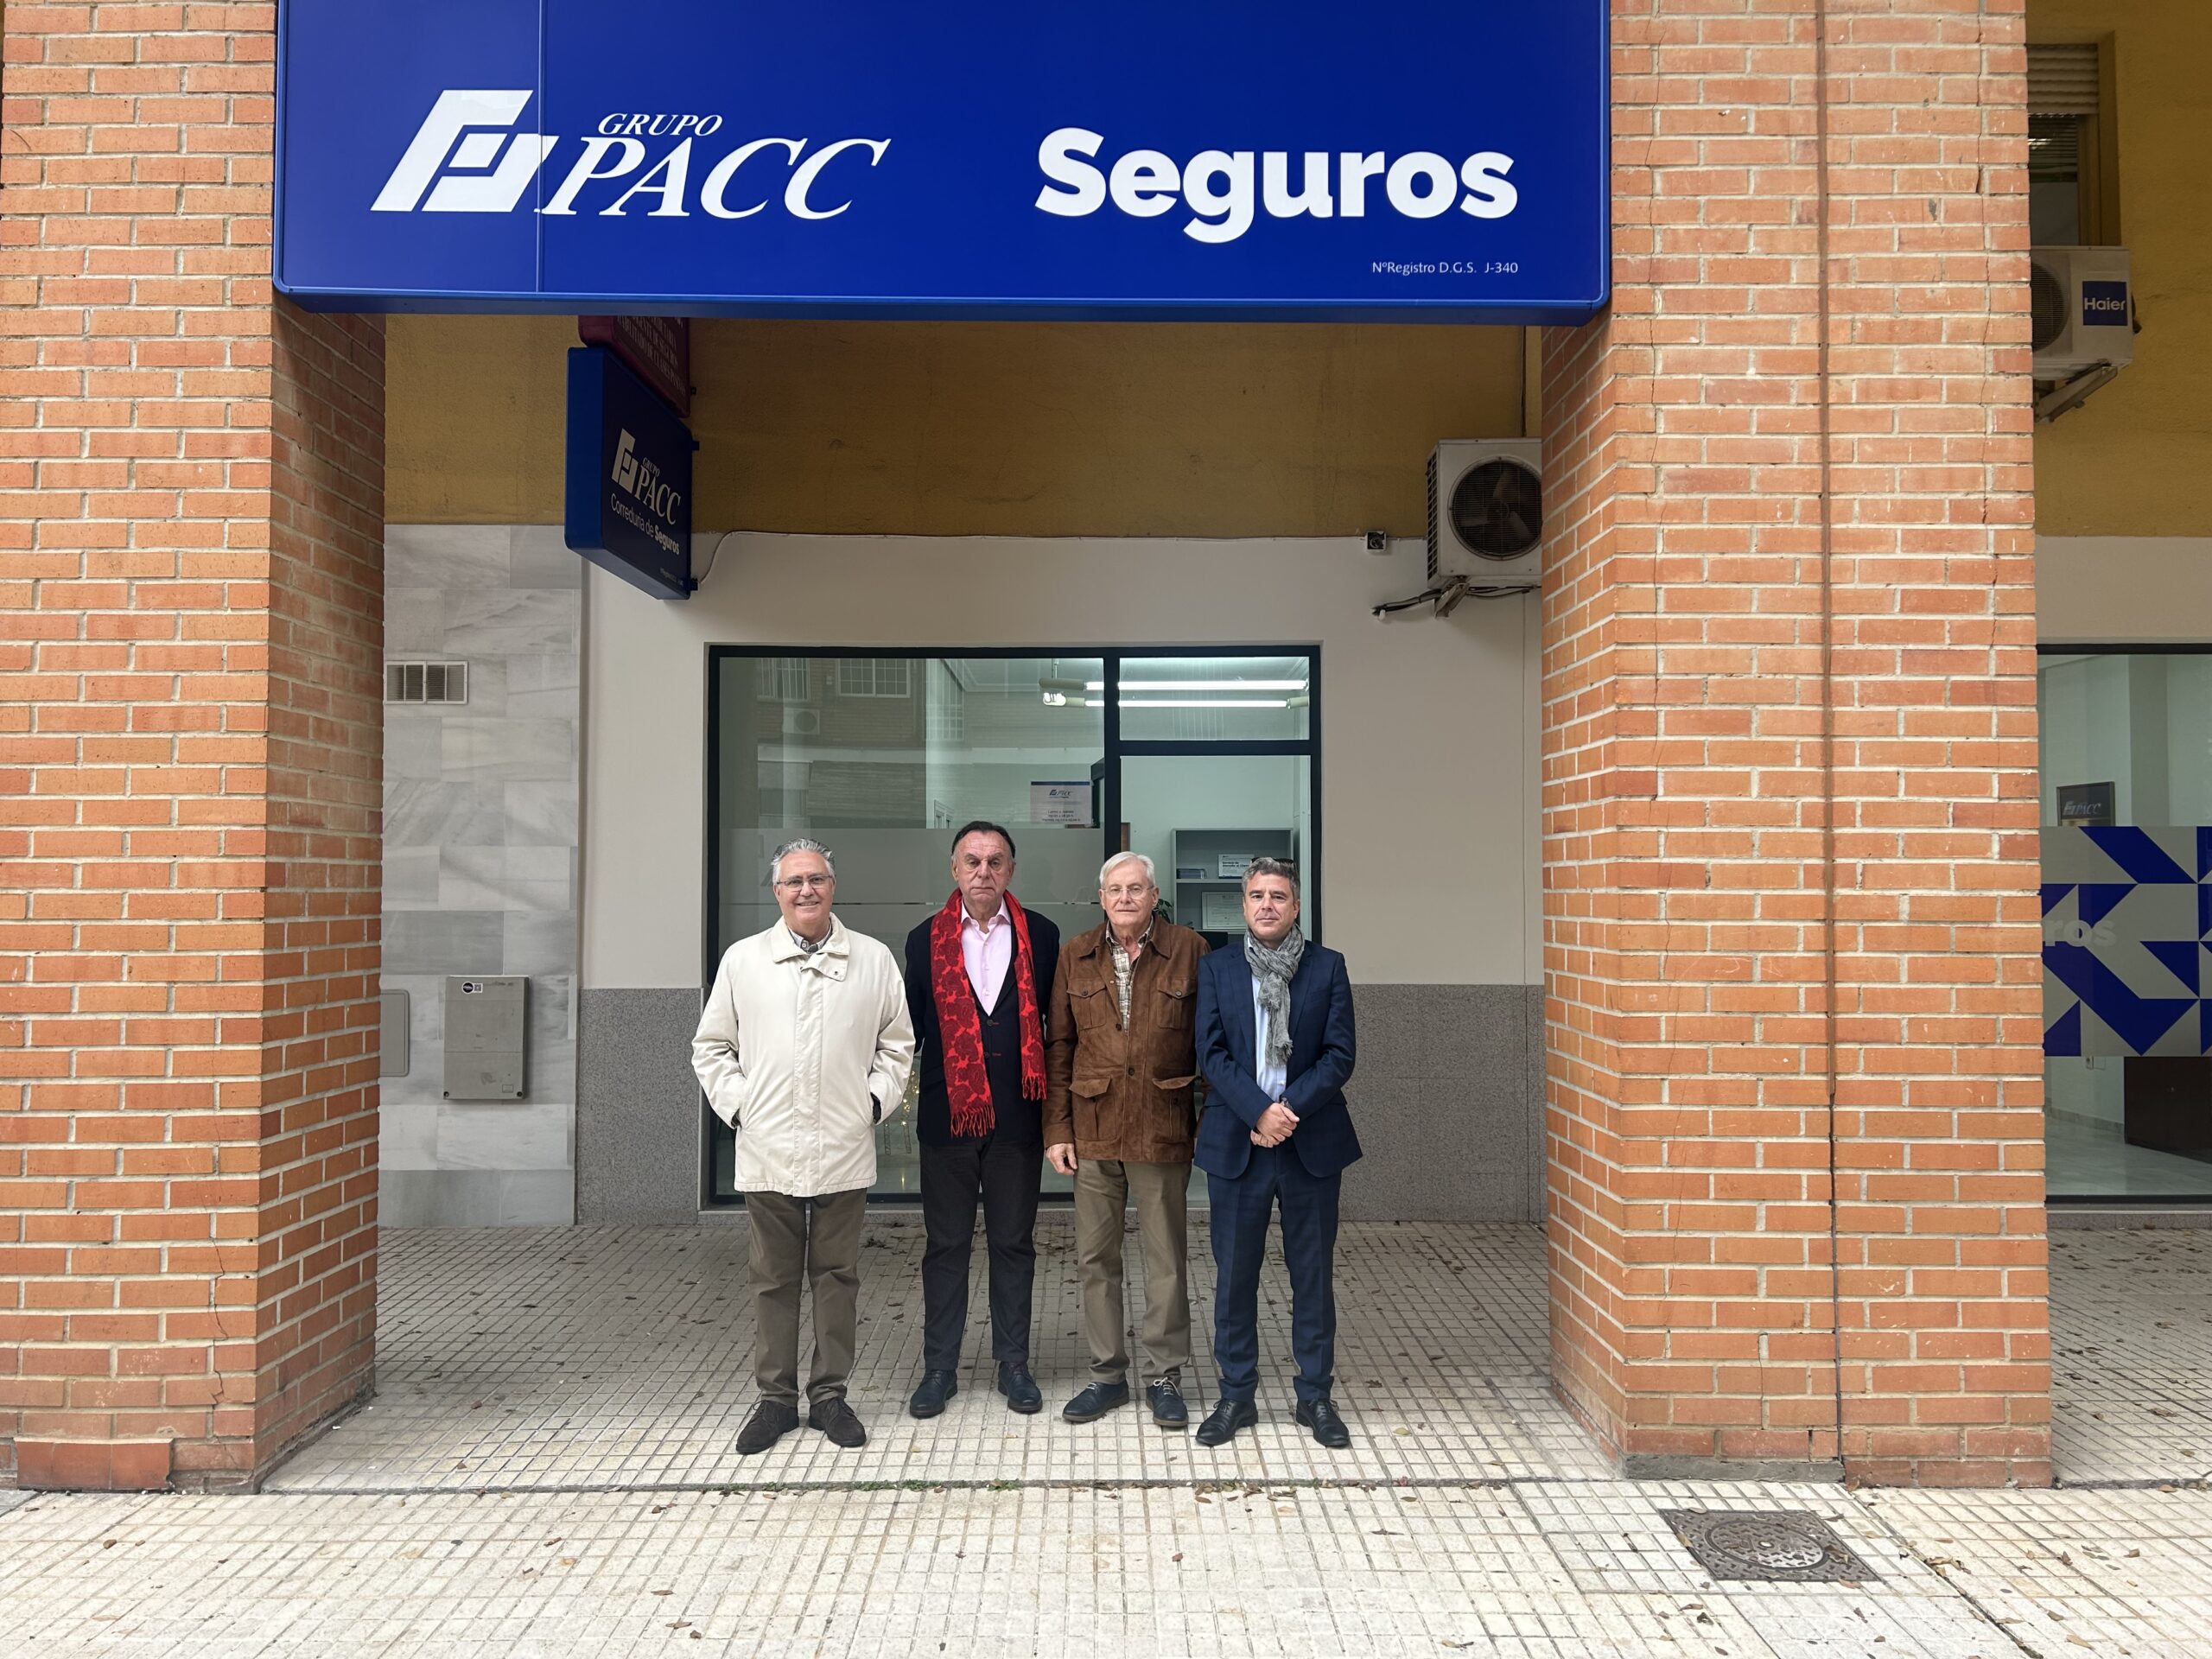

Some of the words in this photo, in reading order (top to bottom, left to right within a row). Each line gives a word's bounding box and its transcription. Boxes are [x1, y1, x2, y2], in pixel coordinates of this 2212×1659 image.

[598, 112, 723, 136] GRUPO
[533, 136, 892, 219] PACC
[1034, 127, 1518, 244] Seguros
[1439, 262, 1477, 274] D.G.S.
[1484, 262, 1519, 274] J-340
[2083, 296, 2126, 311] Haier
[642, 456, 661, 478] GRUPO
[634, 464, 682, 525] PACC
[645, 518, 654, 538] de
[654, 524, 680, 556] Seguros
[2044, 918, 2117, 947] ros
